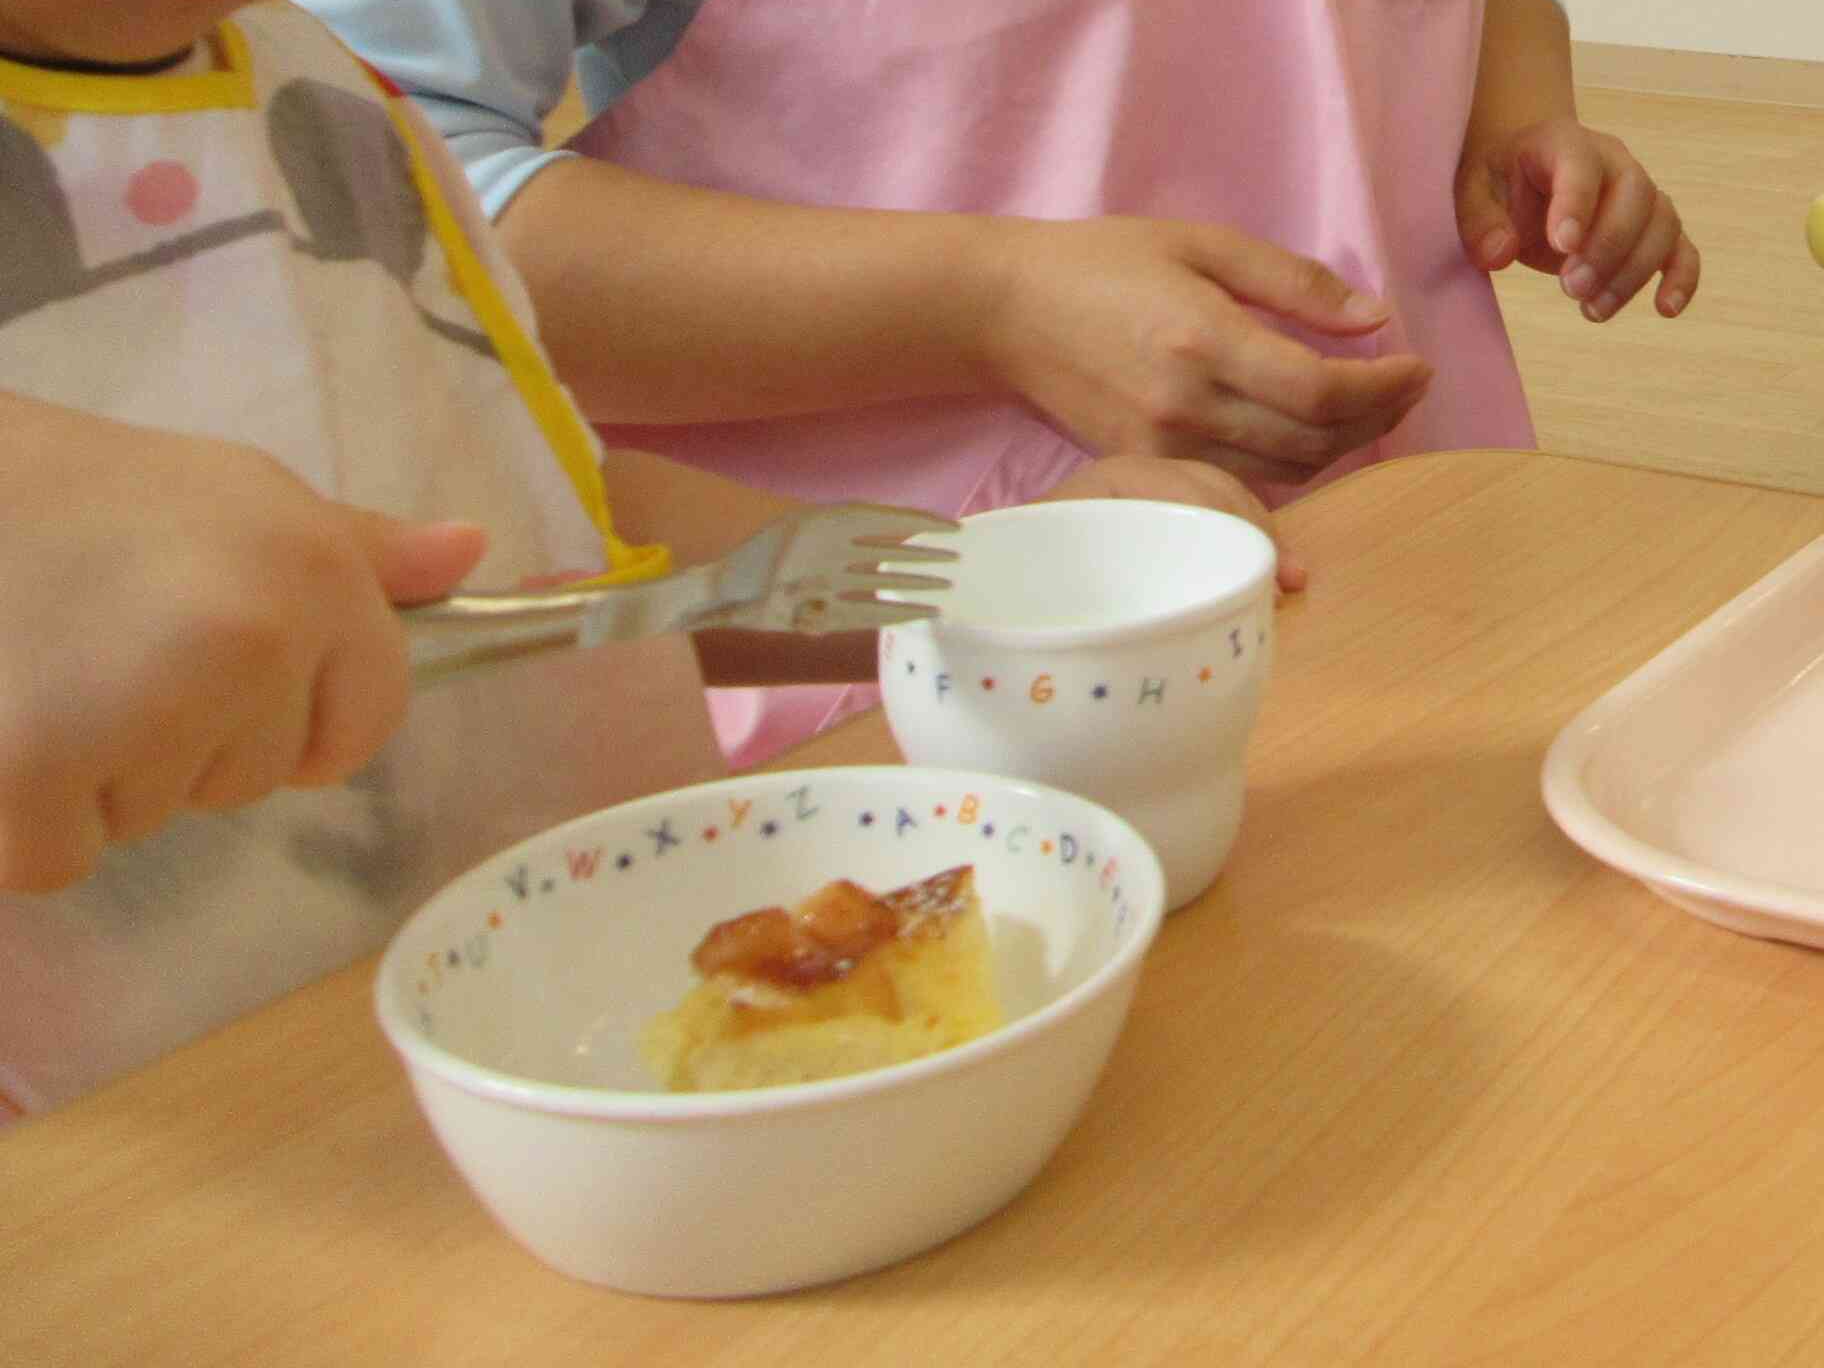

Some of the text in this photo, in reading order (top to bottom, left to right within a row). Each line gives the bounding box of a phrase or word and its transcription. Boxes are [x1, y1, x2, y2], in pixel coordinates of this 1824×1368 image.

[934, 628, 1243, 706] F G H I
[506, 865, 531, 899] V
[565, 846, 605, 881] W
[645, 819, 682, 855] X
[728, 797, 752, 828] Y
[786, 784, 820, 822] Z
[896, 807, 918, 837] A
[956, 792, 981, 825] B
[1005, 825, 1029, 853] C
[1059, 832, 1079, 865] D
